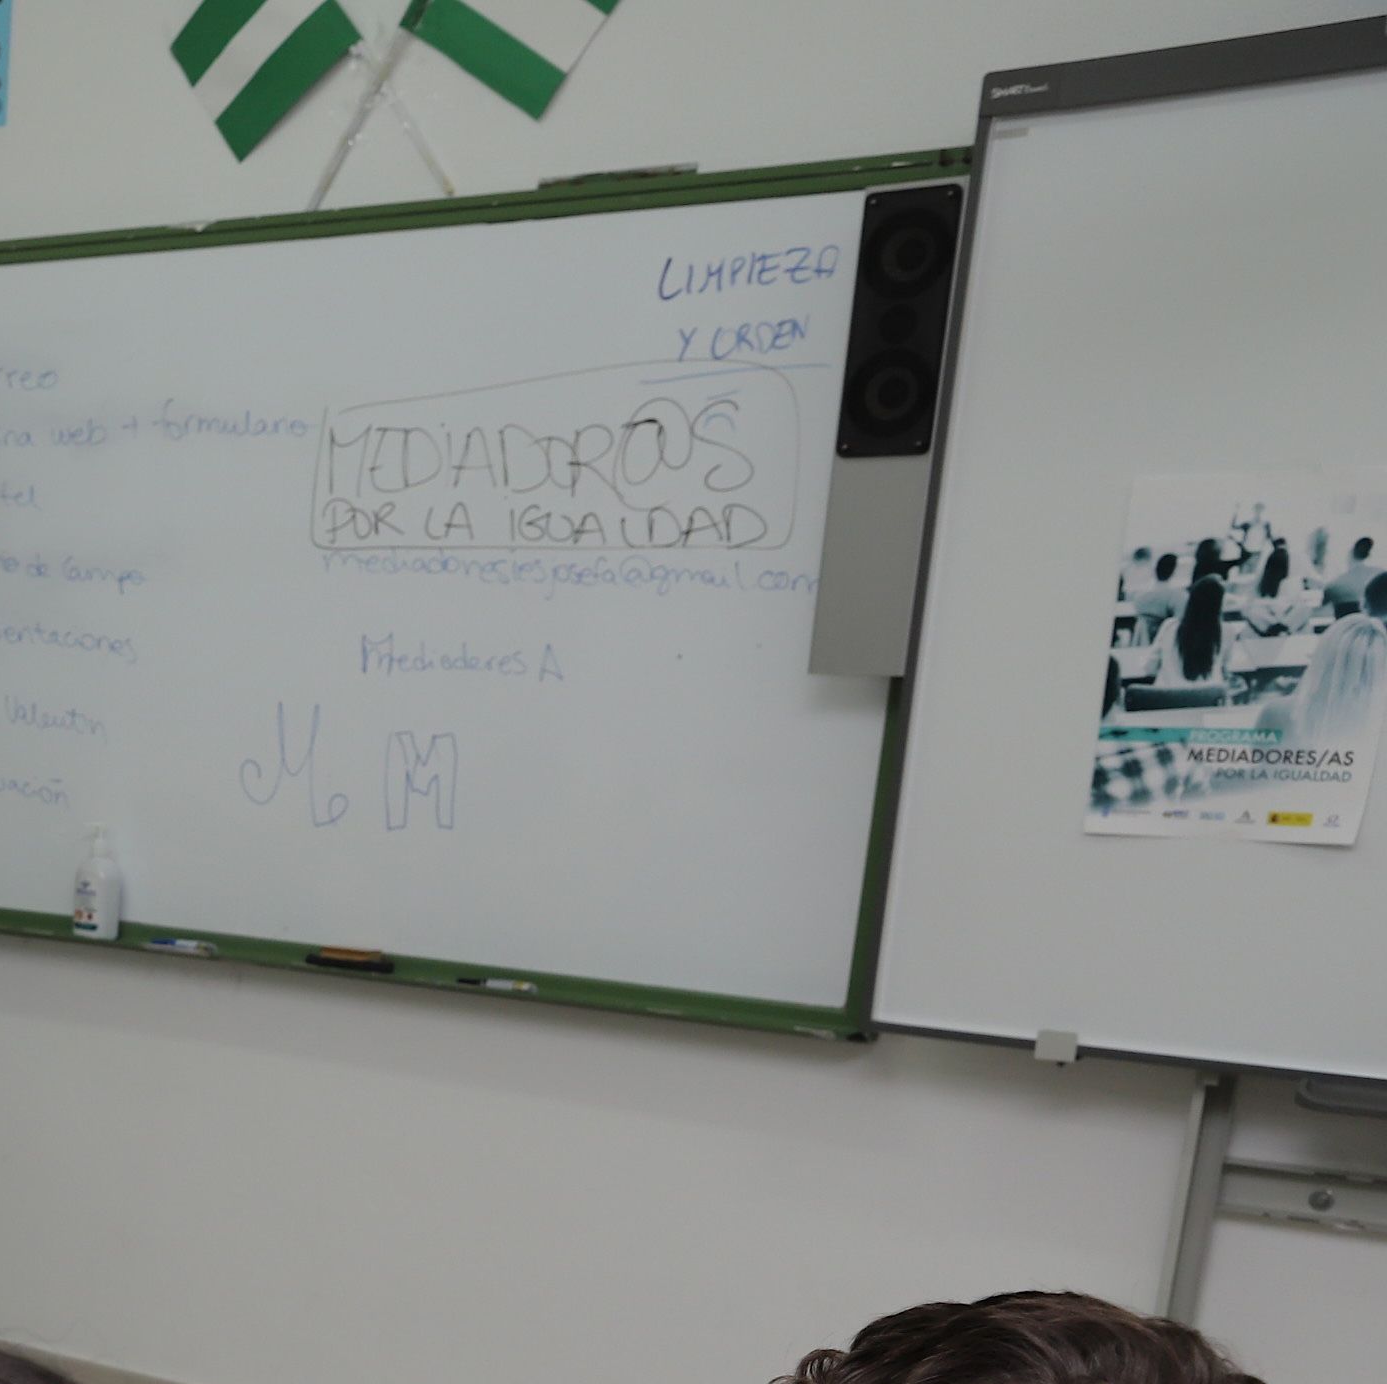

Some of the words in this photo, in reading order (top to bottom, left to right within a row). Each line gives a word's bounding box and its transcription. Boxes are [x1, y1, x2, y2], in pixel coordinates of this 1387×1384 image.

[656, 244, 840, 302] LIMPIEZA
[676, 326, 698, 363] Y
[710, 315, 811, 361] ORDEN
[51, 419, 109, 447] web
[322, 498, 406, 546] POR
[424, 500, 476, 541] LA
[538, 643, 565, 682] A
[1187, 748, 1355, 767] MEDIADORES/AS
[1215, 768, 1245, 780] POR
[1251, 769, 1269, 781] LA
[1273, 770, 1353, 784] IGUALDAD
